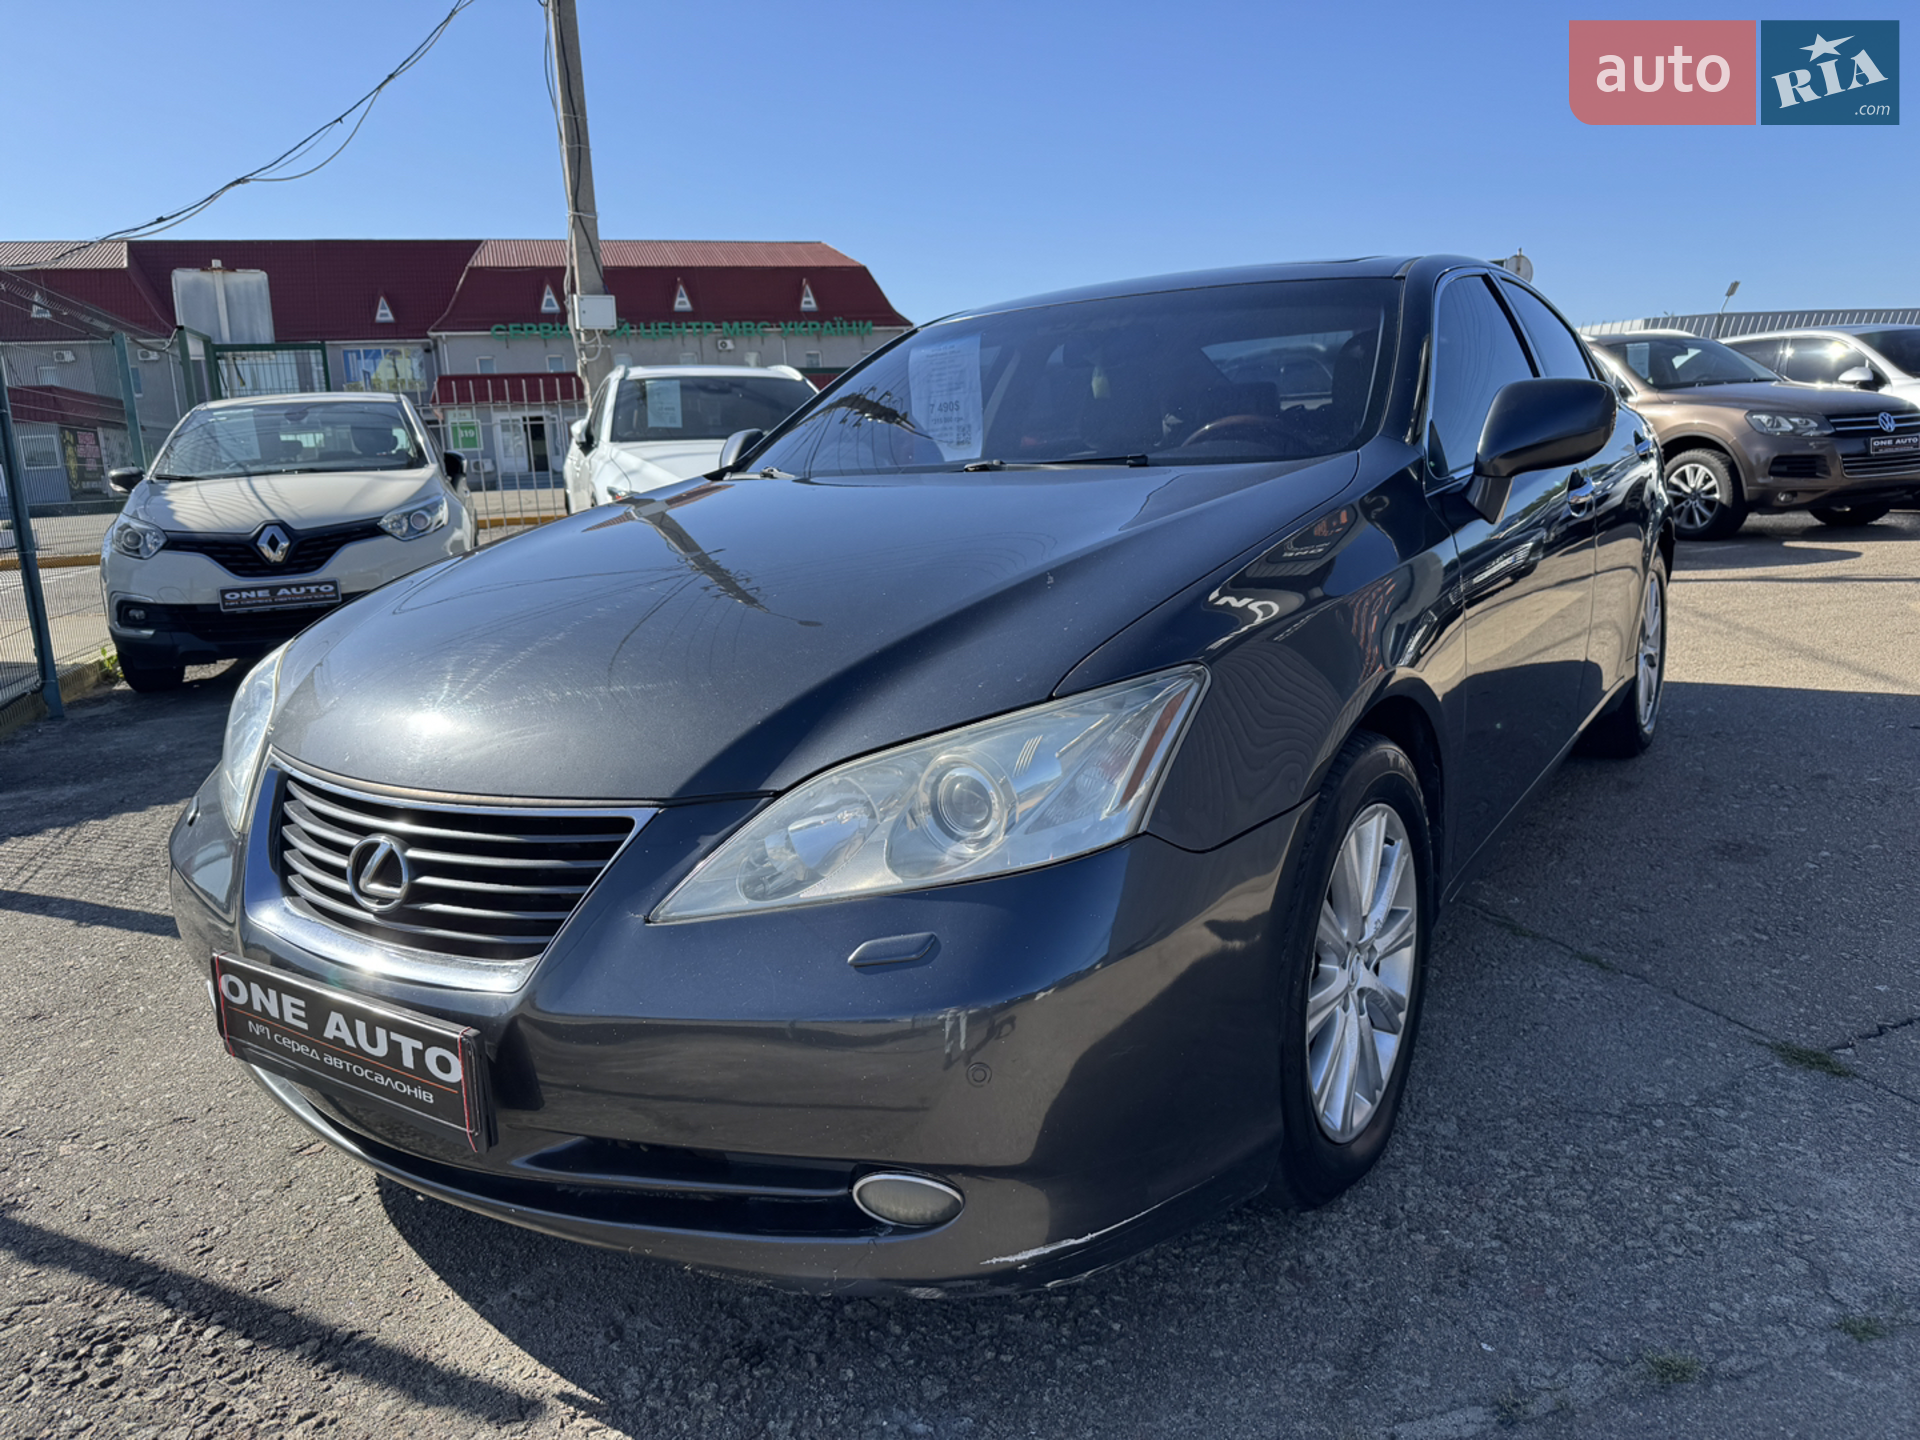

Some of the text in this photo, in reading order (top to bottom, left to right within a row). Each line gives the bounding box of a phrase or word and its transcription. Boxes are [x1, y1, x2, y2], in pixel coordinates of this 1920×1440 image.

[640, 321, 716, 342] ЦЕНТР
[721, 321, 771, 337] МВС
[779, 316, 873, 337] УКРАЇНИ
[1873, 437, 1918, 447] ONE AUTO
[224, 588, 271, 601] ONE
[276, 584, 335, 596] AUTO
[218, 973, 463, 1084] ONE AUTO
[274, 1033, 321, 1062] серед
[323, 1053, 435, 1104] автосалонів
